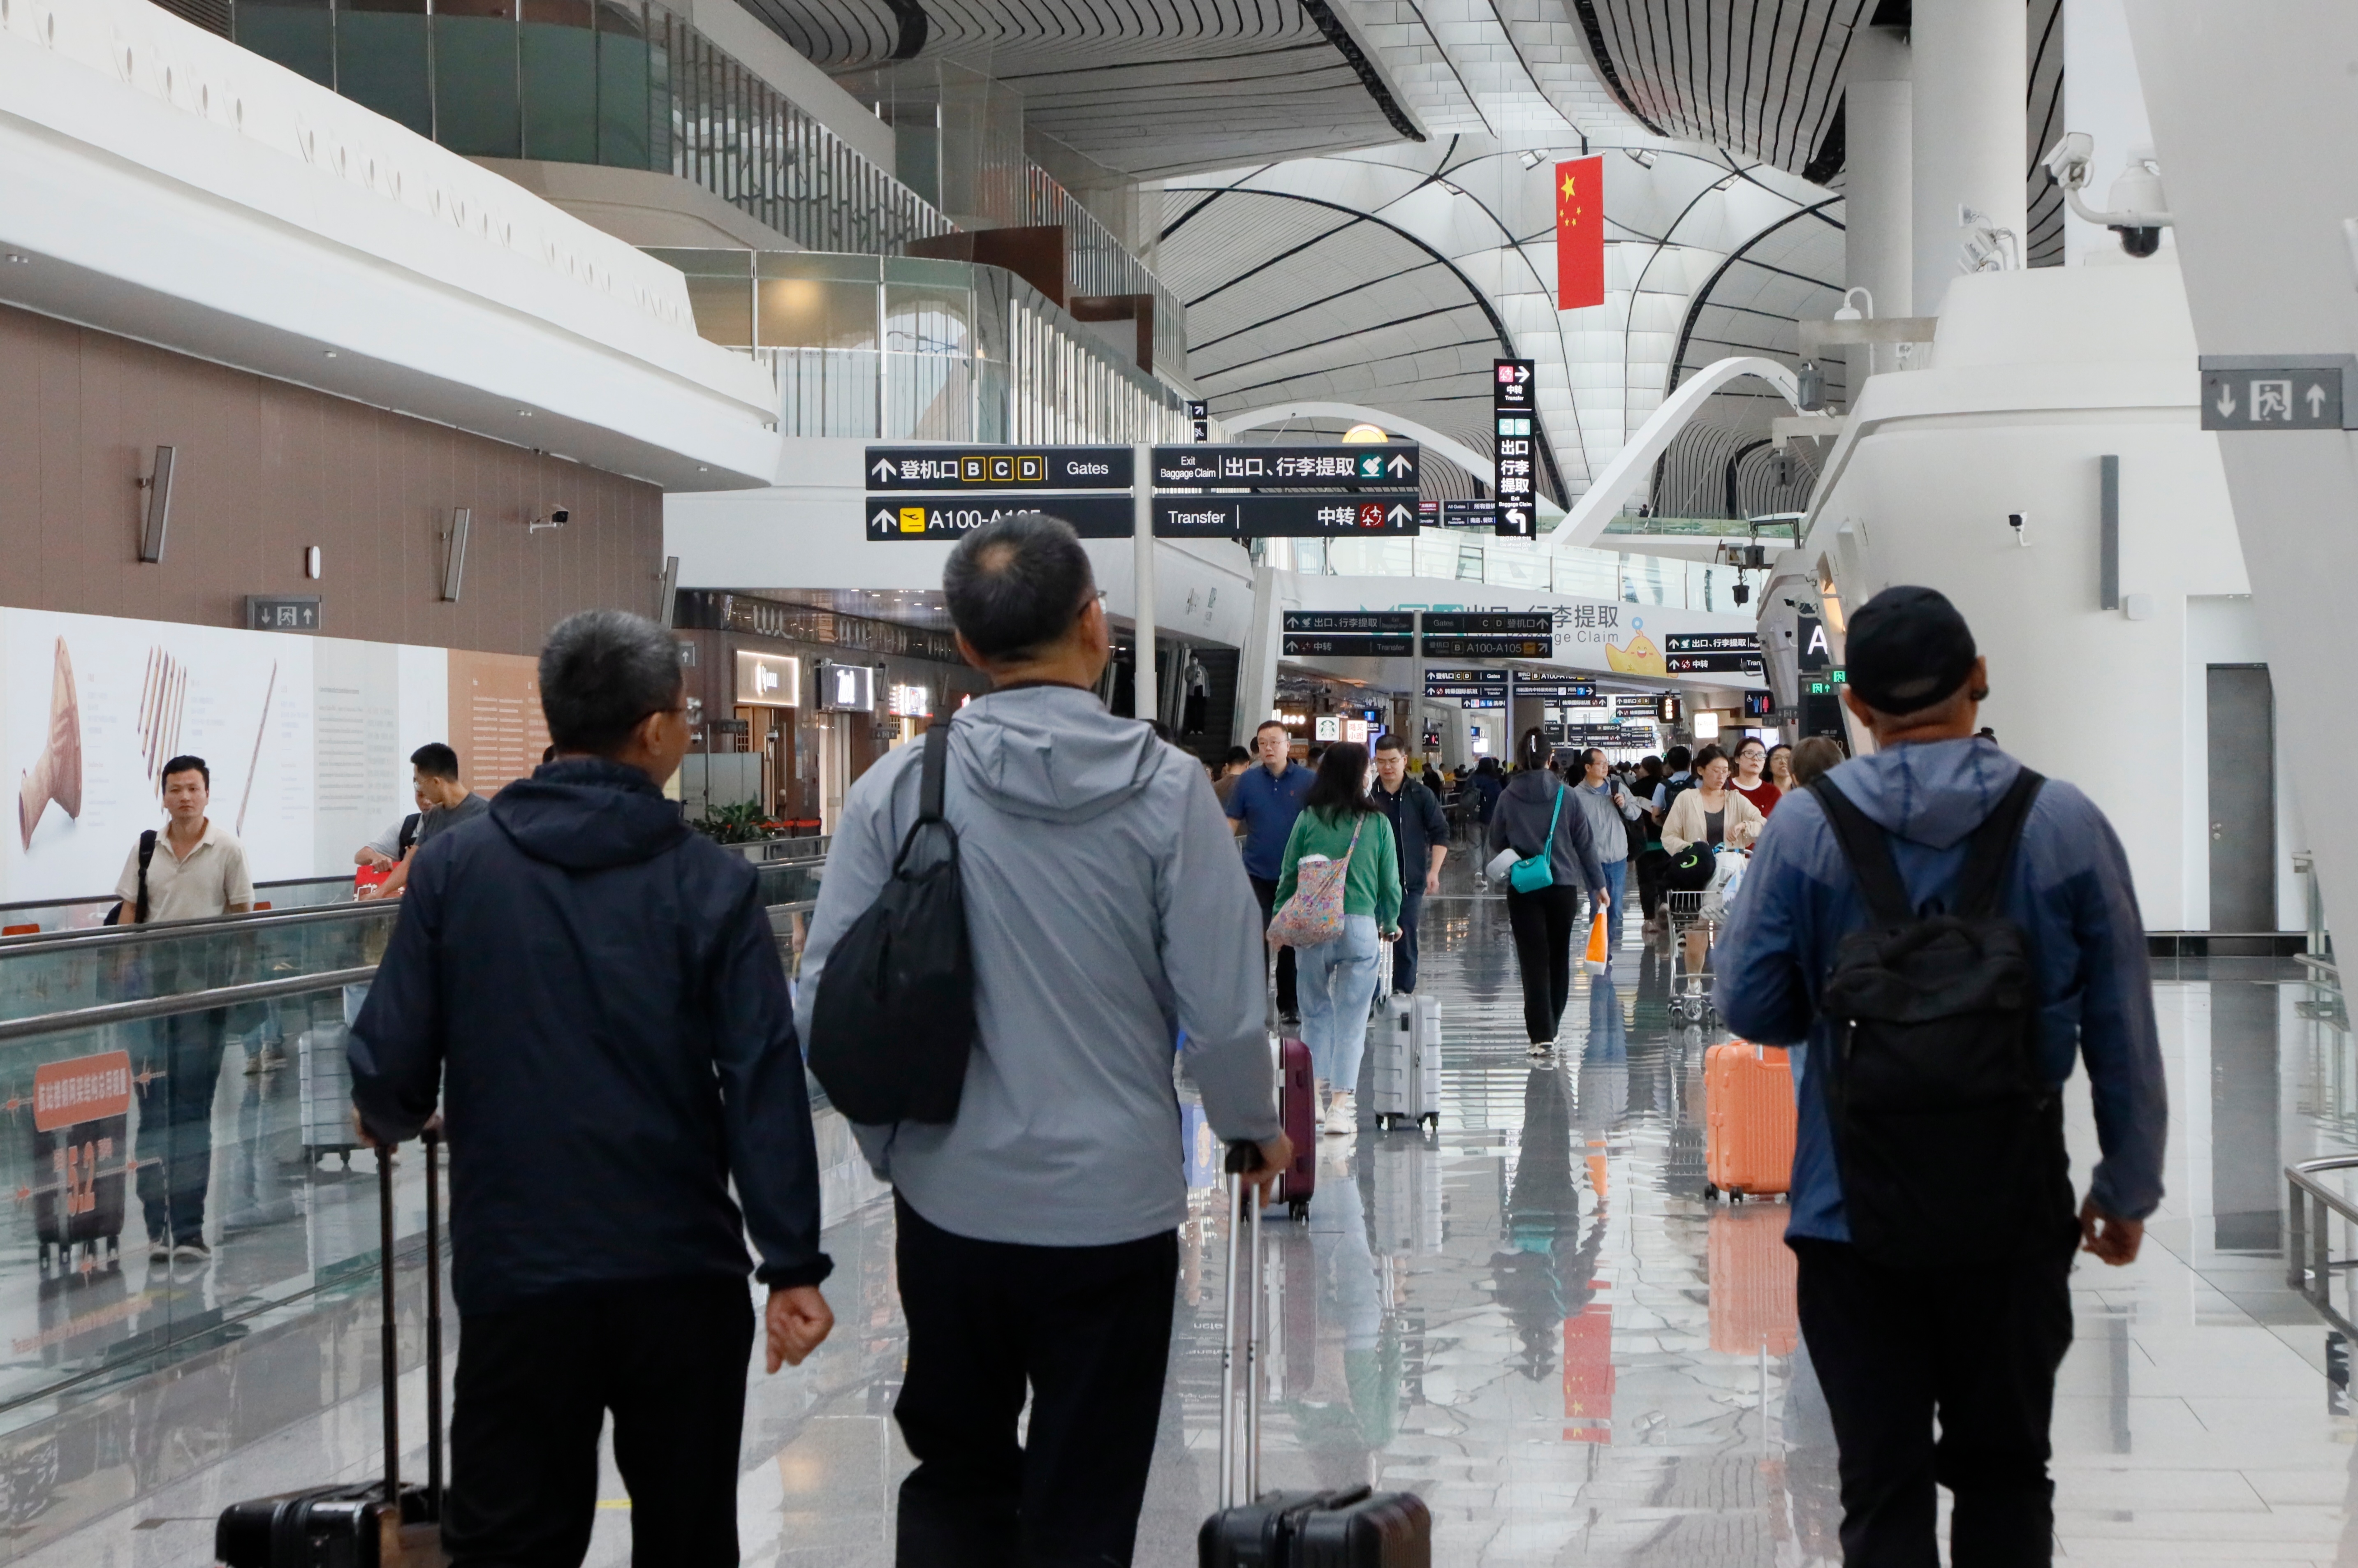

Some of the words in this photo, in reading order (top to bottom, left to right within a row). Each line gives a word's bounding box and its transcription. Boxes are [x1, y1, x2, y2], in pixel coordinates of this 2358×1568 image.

[1506, 385, 1522, 394] 中转
[1501, 439, 1529, 455] 出口
[1181, 456, 1195, 465] Exit
[1225, 457, 1355, 477] 出口、行李提取
[901, 460, 958, 479] 登机口
[968, 463, 979, 476] B
[995, 462, 1008, 476] C
[1024, 463, 1035, 475] D
[1067, 461, 1109, 475] Gates
[1160, 468, 1193, 480] Baggage
[1195, 468, 1216, 478] Claim
[1501, 460, 1529, 475] 行李
[1501, 478, 1529, 493] 提取
[928, 510, 1041, 529] A100-A
[1168, 511, 1226, 524] Transfer
[1318, 506, 1355, 526] 中转
[1314, 618, 1377, 628] 出口、行李提取
[1507, 618, 1535, 628] 登机口
[1577, 630, 1619, 643] Claim
[1807, 625, 1828, 655] A
[1313, 642, 1332, 651] 中转
[1467, 643, 1522, 652] A100-A105
[1692, 639, 1746, 648] 出口、行李提取
[1692, 660, 1708, 668] 中转
